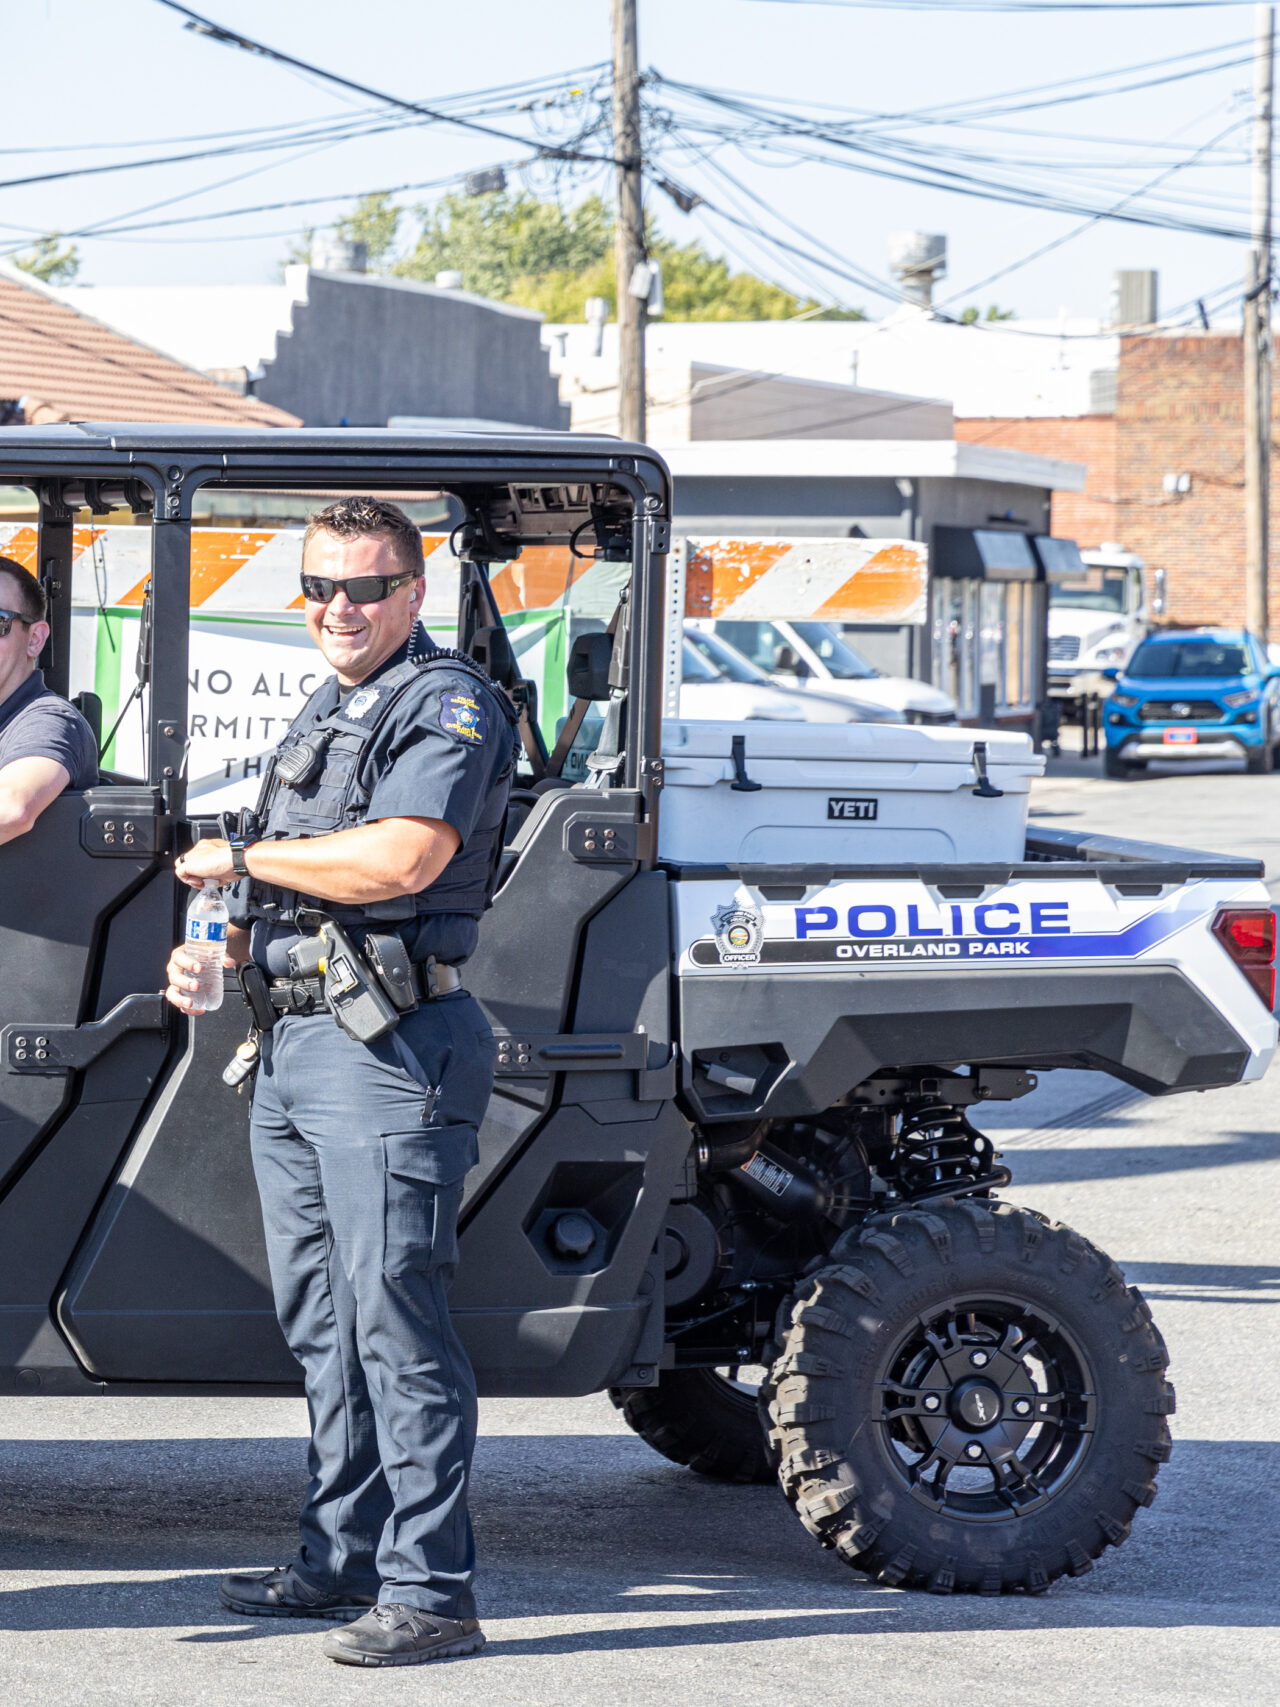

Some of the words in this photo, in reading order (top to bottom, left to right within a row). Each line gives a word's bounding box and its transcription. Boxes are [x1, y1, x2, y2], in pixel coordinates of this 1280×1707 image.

[188, 669, 232, 695] NO
[251, 672, 316, 698] ALC
[190, 714, 294, 740] RMITT
[222, 757, 262, 778] TH
[829, 800, 876, 818] YETI
[794, 902, 1071, 939] POLICE
[836, 943, 960, 959] OVERLAND
[968, 941, 1031, 956] PARK
